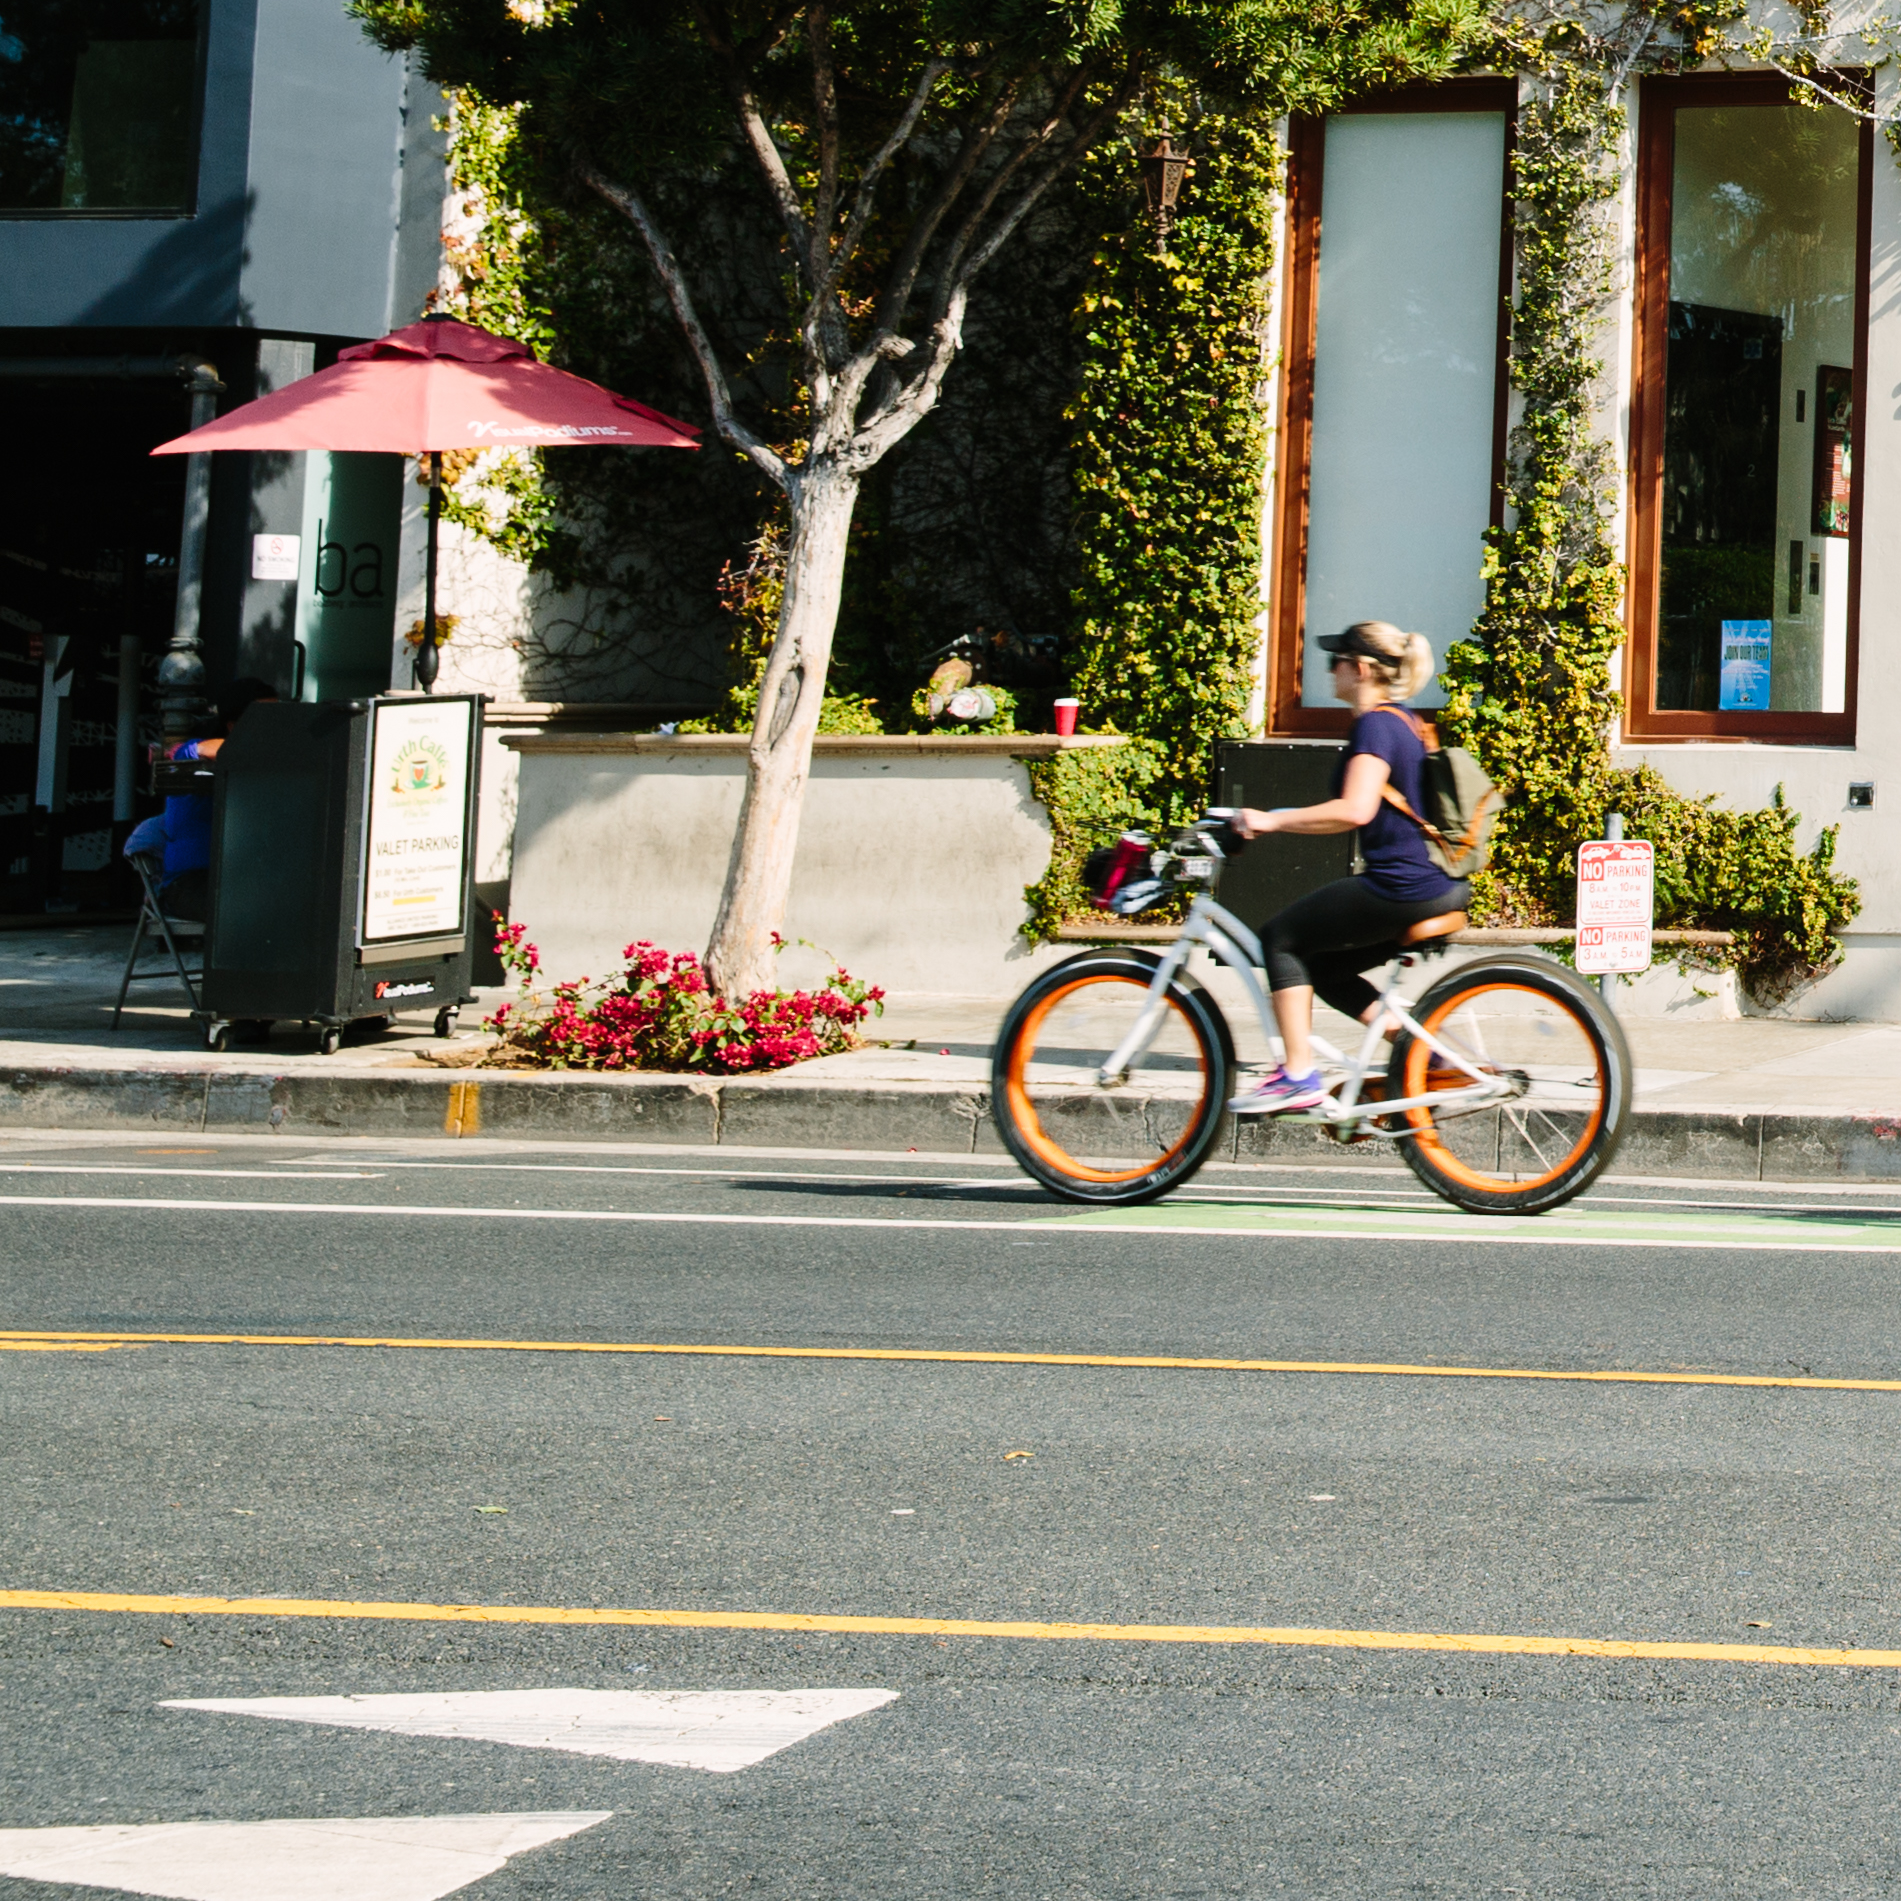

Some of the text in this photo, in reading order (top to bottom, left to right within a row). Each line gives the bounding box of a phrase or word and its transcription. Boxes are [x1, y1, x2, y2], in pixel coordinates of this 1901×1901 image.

[314, 518, 385, 598] ba
[1724, 645, 1769, 660] JOIN OUR TEAM
[390, 739, 417, 773] Urth
[376, 835, 459, 856] VALET PARKING
[1583, 862, 1648, 880] NO PARKING
[1590, 899, 1641, 910] VALET ZONE
[1581, 928, 1646, 945] NO PARKING
